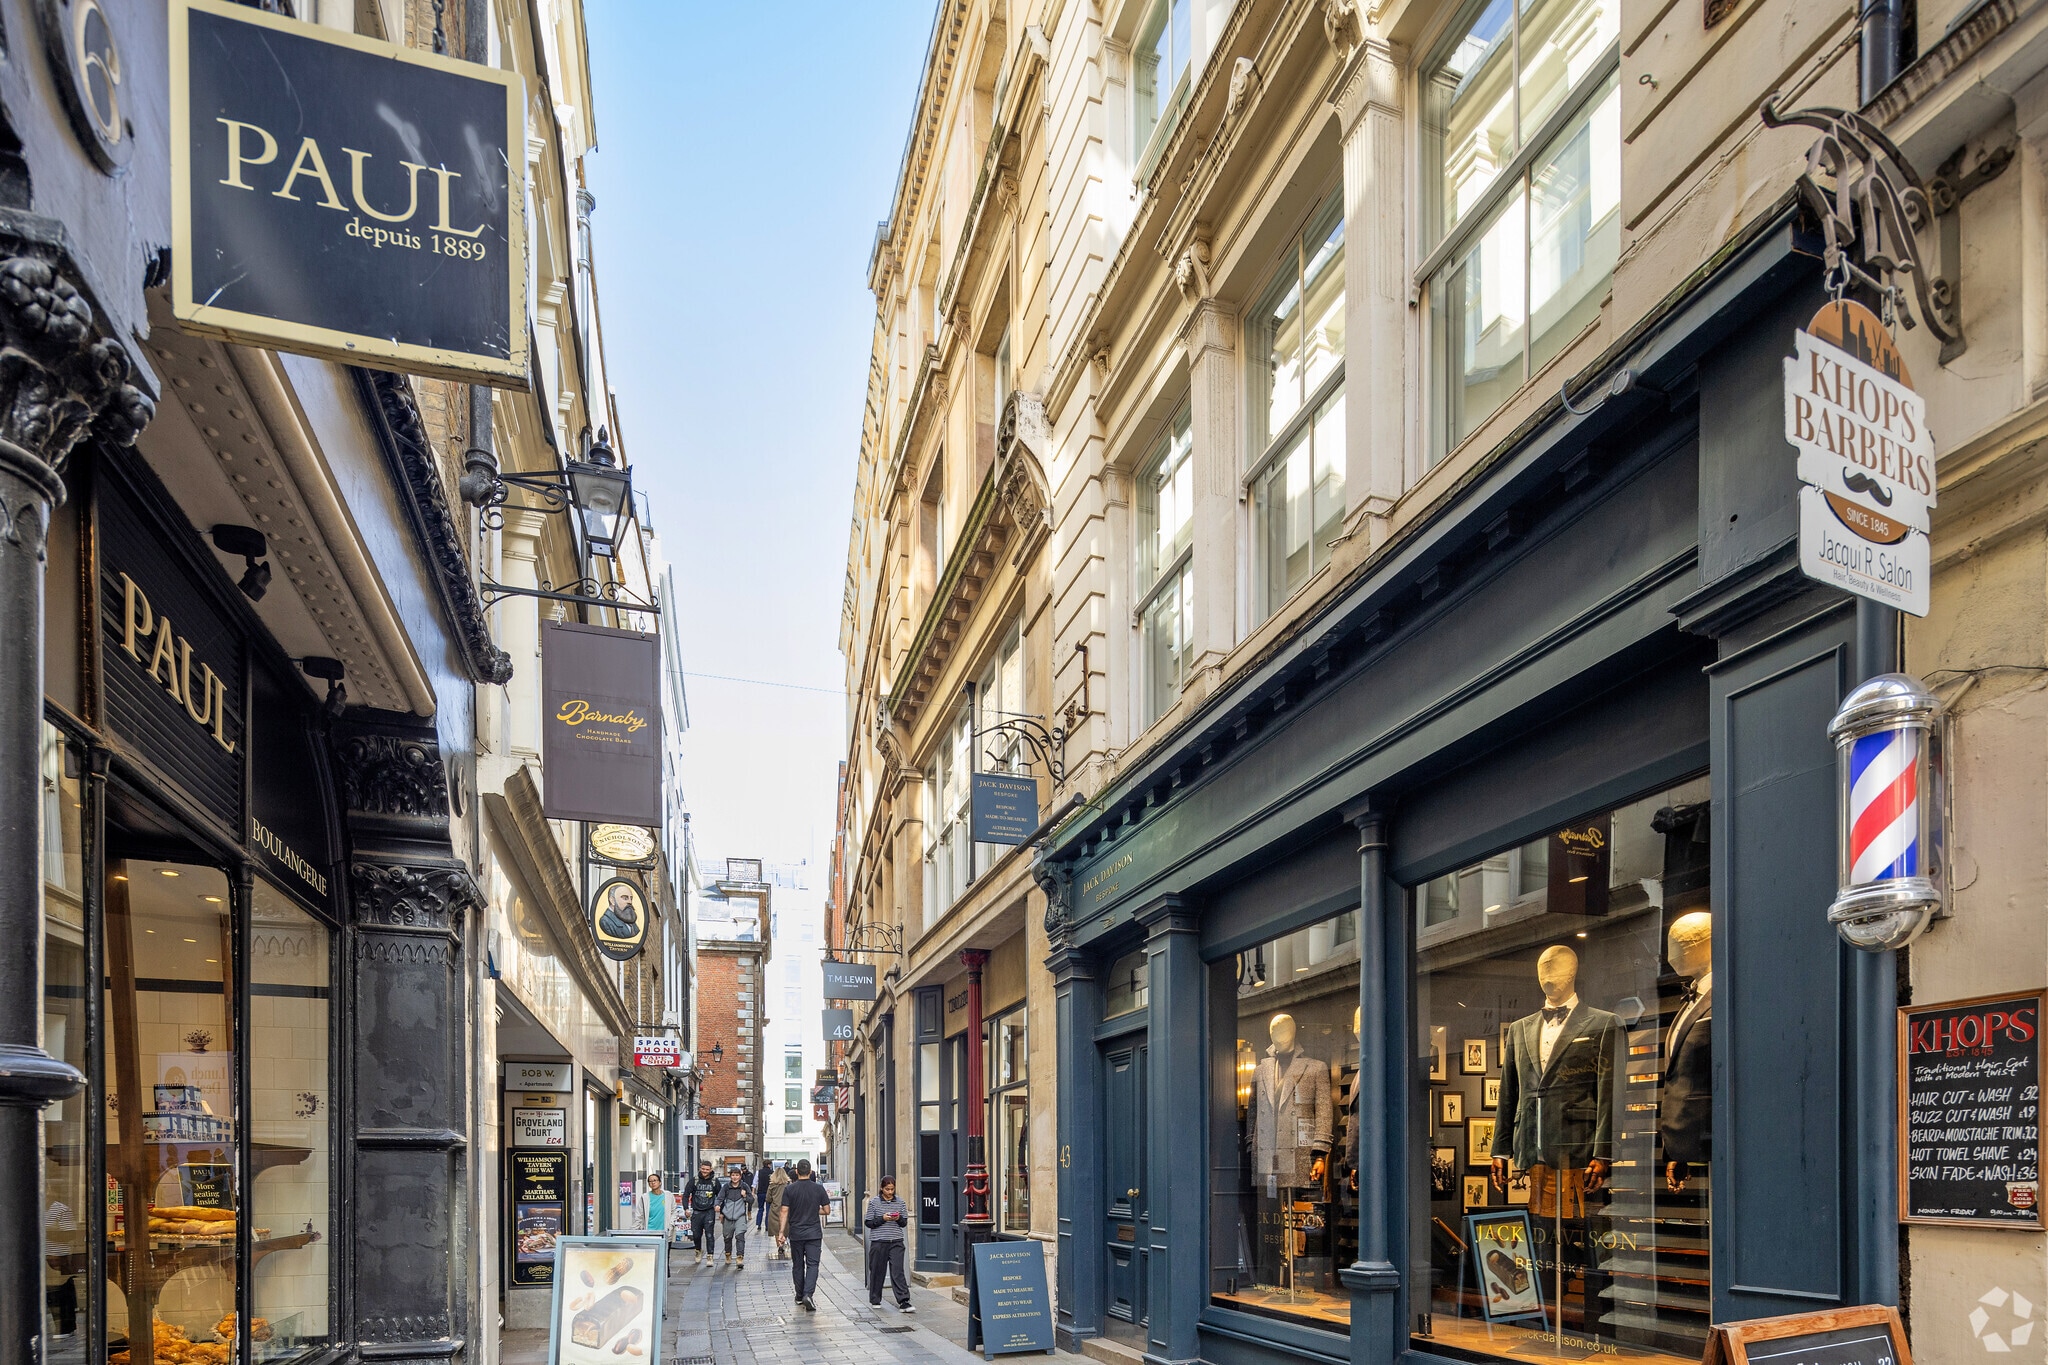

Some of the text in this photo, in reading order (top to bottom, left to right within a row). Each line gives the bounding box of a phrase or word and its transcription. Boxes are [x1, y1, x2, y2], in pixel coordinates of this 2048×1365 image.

[216, 117, 485, 238] PAUL
[344, 217, 486, 262] depuis 1889
[1809, 349, 1916, 443] KHOPS
[1793, 393, 1931, 496] BARBERS
[1846, 507, 1889, 537] SINCE 1845
[1819, 530, 1913, 591] Jacqui R Salon
[1833, 569, 1902, 602] Hair, Beauty & Wellness
[119, 571, 235, 753] PAUL
[556, 700, 648, 732] Barnaby
[999, 783, 1031, 791] DAVISON
[252, 817, 327, 896] BOULANGERIE
[1083, 851, 1133, 897] JACK DAVISON
[1095, 882, 1119, 903] BESPOKE
[827, 975, 873, 985] T.M.LEWIN
[833, 1025, 851, 1038] 46
[1908, 1008, 2035, 1054] KHOPS
[1914, 1056, 2029, 1075] Traditional Hair Cut
[1945, 1070, 1980, 1079] Modern
[1984, 1066, 2017, 1078] twist
[1911, 1092, 1939, 1106] HAIR
[1943, 1090, 1969, 1105] CUT
[1978, 1087, 2013, 1103] WASH
[2019, 1085, 2038, 1100] £32
[516, 1117, 563, 1127] GROVELAND
[1911, 1110, 1943, 1124] BUZZ
[1945, 1109, 1971, 1123] CUT
[1978, 1105, 2012, 1121] WASH
[525, 1127, 552, 1137] COURT
[1911, 1129, 1941, 1143] BEARD
[1945, 1126, 2000, 1141] MOUSTACHE
[2002, 1127, 2022, 1140] TRIM
[1060, 1145, 1071, 1168] 43
[1911, 1147, 1934, 1161] HOT
[1936, 1147, 1970, 1161] TOWEL
[1973, 1146, 2010, 1161] SHAVE
[1910, 1166, 1939, 1180] SKIN
[1942, 1166, 1975, 1181] FADE
[1984, 1163, 2016, 1181] WASH
[2017, 1166, 2037, 1180] £36
[194, 1190, 220, 1199] seating
[1475, 1224, 1638, 1251] JACK DAVISON
[1515, 1257, 1588, 1273] BESPOKE
